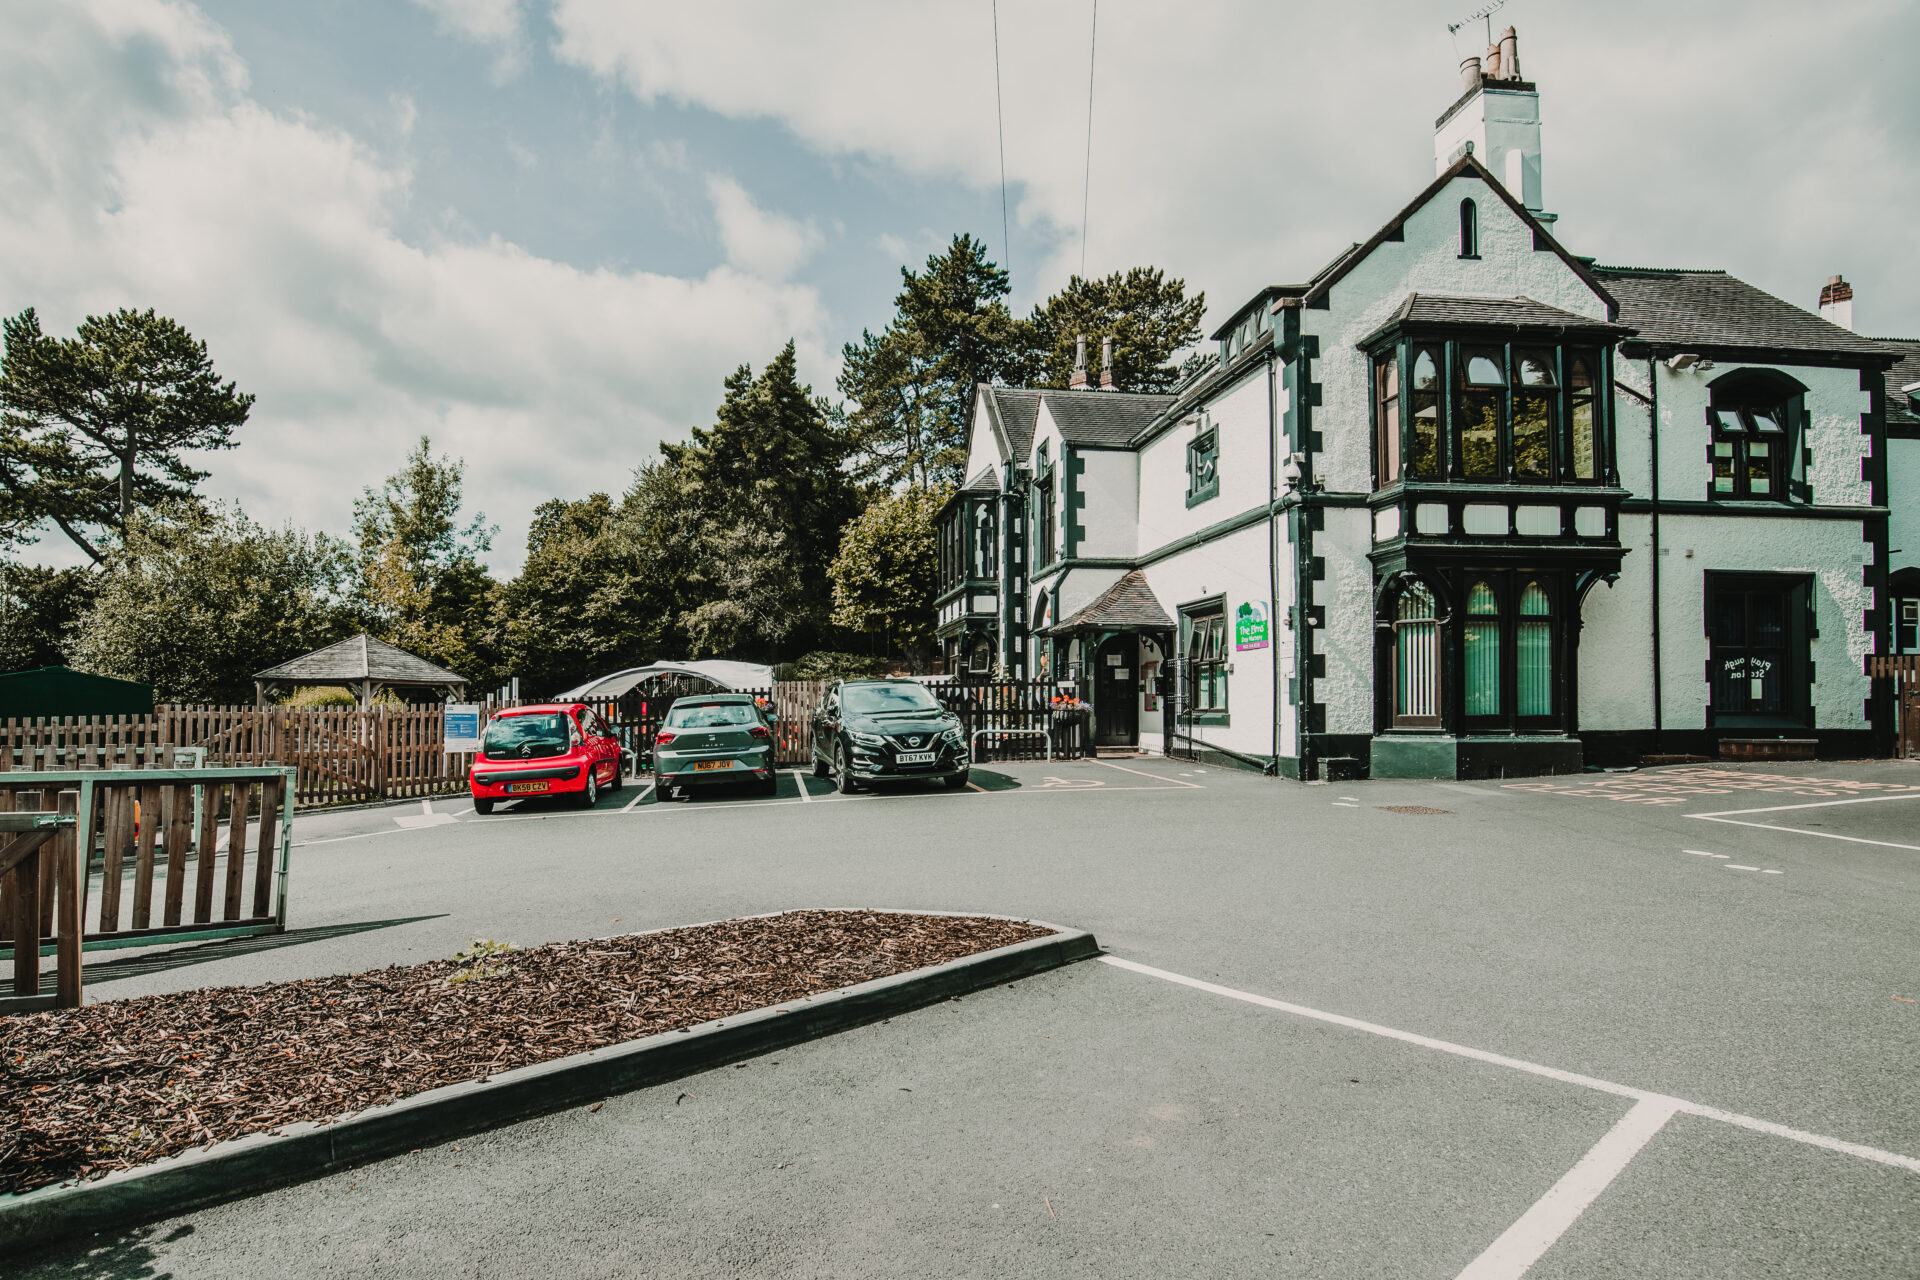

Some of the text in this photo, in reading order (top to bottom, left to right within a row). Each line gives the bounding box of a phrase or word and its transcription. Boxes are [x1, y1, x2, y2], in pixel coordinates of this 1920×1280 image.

[1239, 624, 1264, 635] The Elms
[532, 782, 546, 790] CZV
[1501, 783, 1688, 807] CLEAR
